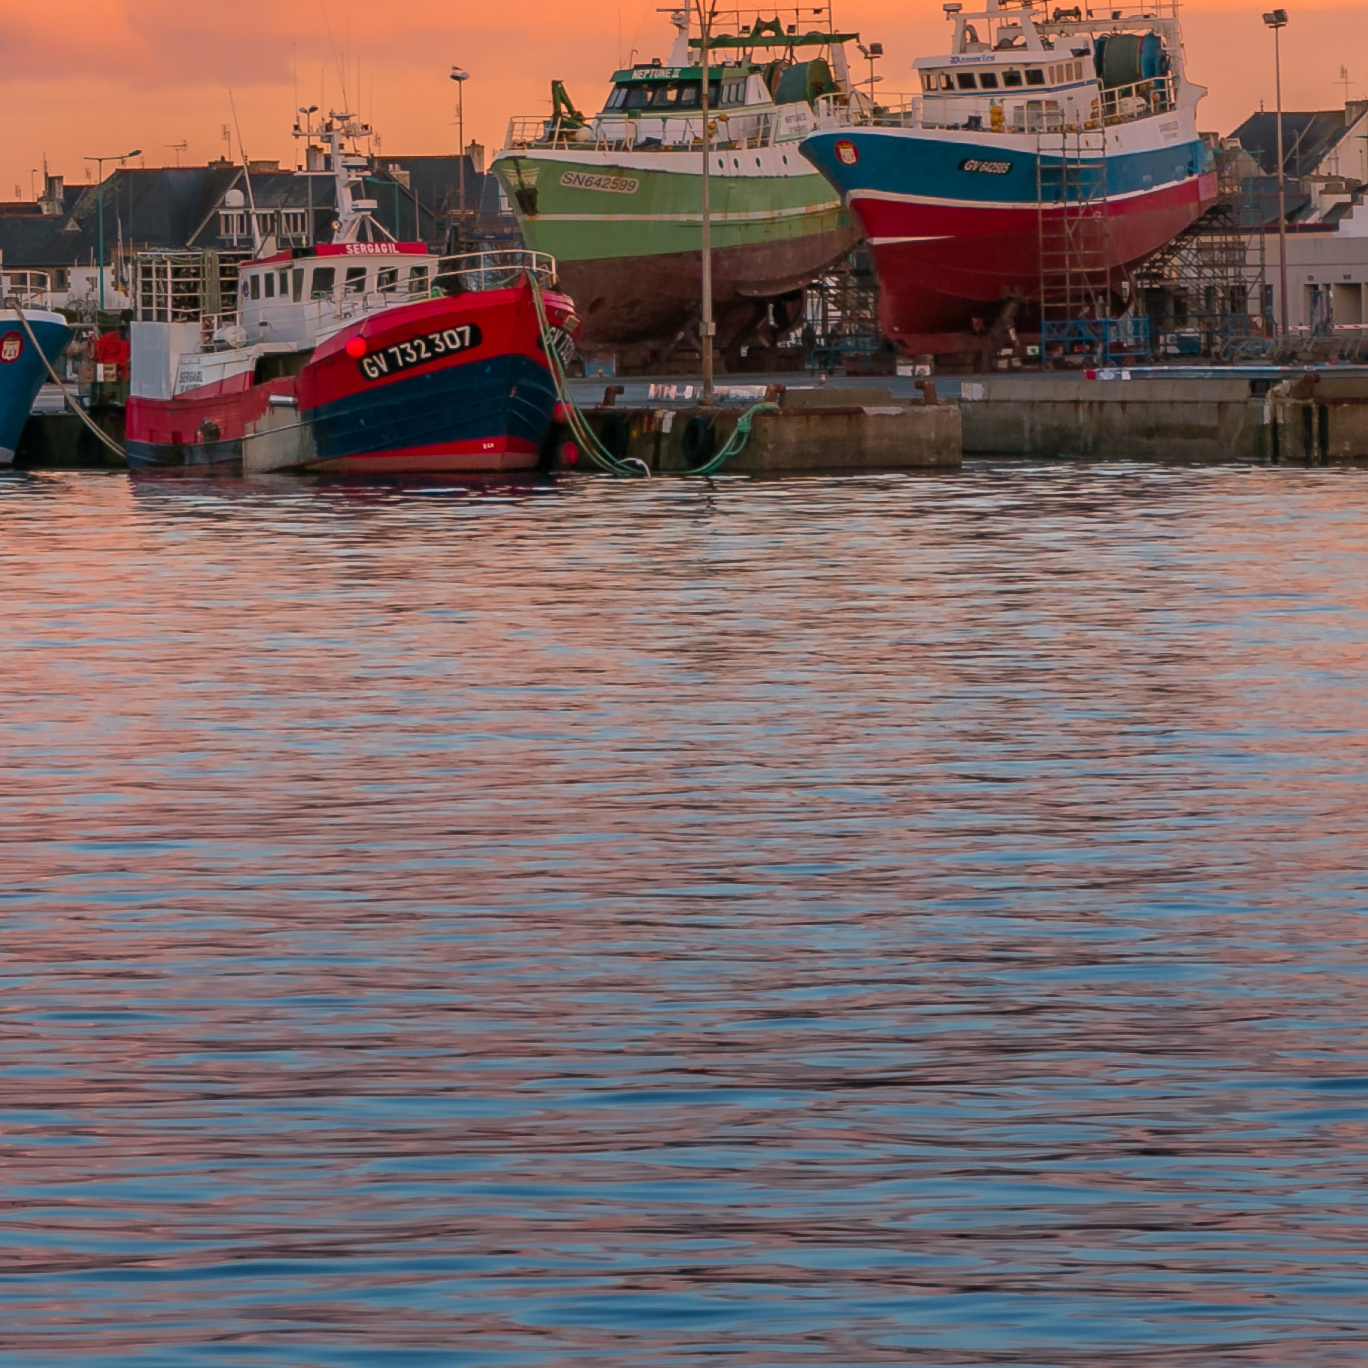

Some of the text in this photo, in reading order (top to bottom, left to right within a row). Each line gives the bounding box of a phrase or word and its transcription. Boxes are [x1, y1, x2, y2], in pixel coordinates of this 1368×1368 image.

[631, 69, 672, 80] NEPTUNE
[964, 160, 981, 171] GV
[562, 172, 637, 192] SN642599
[345, 243, 399, 254] SERGAGIL
[363, 353, 390, 379] GV
